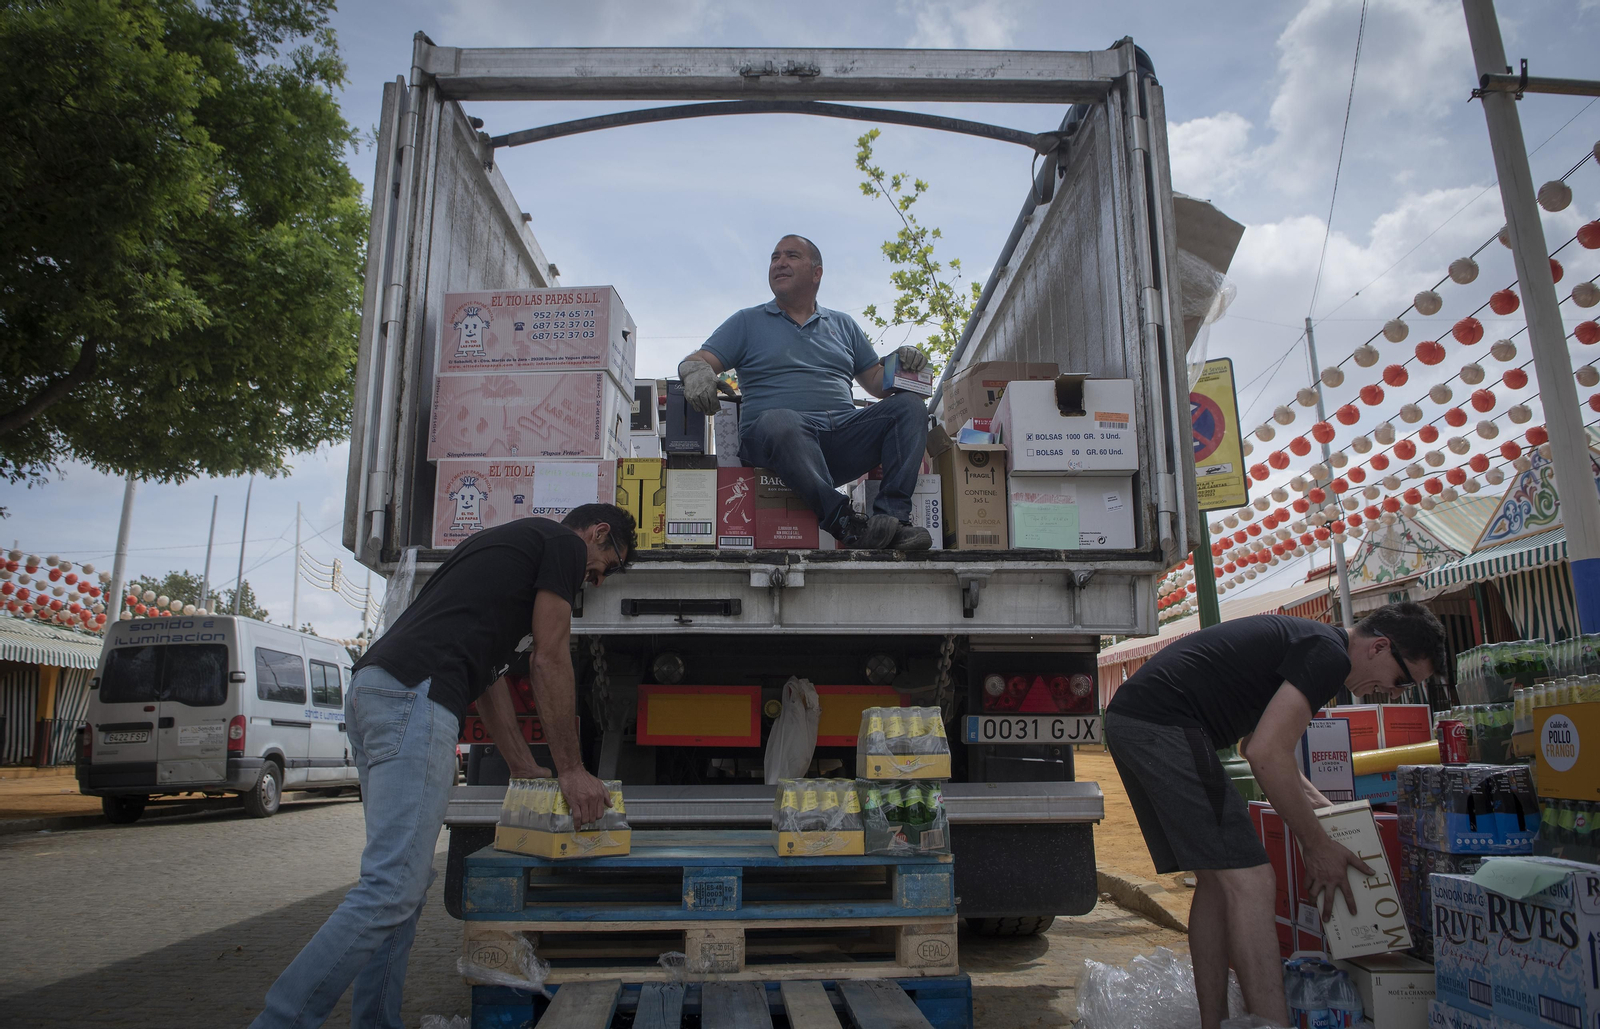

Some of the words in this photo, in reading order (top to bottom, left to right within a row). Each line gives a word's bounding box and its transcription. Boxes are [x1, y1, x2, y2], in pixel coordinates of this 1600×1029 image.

[491, 295, 503, 307] EL
[505, 295, 522, 307] TIO
[524, 294, 542, 306] LAS
[545, 294, 574, 306] PAPAS
[576, 293, 601, 304] S.L.L.
[533, 311, 551, 319] 952
[584, 310, 594, 318] 71
[532, 321, 550, 329] 687
[553, 321, 565, 329] 52
[568, 321, 580, 329] 37
[582, 320, 595, 328] 02
[532, 332, 550, 340] 687
[1035, 433, 1063, 441] BOLSAS
[1105, 432, 1121, 440] Und.
[1108, 448, 1124, 456] Und.
[489, 465, 502, 477] EL
[504, 465, 522, 477] TIO
[524, 465, 535, 477] LA
[760, 475, 785, 488] BAR
[983, 719, 1039, 740] 0031
[1051, 719, 1096, 740] GJX
[109, 733, 128, 742] 6422
[130, 732, 147, 741] FSP
[1548, 730, 1571, 744] POLLO
[1312, 751, 1348, 764] BEEFEATER
[1545, 744, 1576, 758] FRANGO
[1357, 791, 1390, 800] LUMINIO
[1332, 828, 1361, 839] CHANDON
[1434, 886, 1463, 903] LONDON
[1463, 892, 1478, 906] DRY
[1550, 883, 1569, 899] GIN
[1434, 904, 1488, 945] RIVE
[1486, 892, 1579, 949] RIVES
[922, 944, 946, 957] EPAL
[1442, 937, 1489, 966] Original
[1498, 933, 1570, 970] Original
[1443, 978, 1468, 992] NATURAL
[1501, 984, 1538, 1007] NATURAL
[1501, 996, 1539, 1016] INGREDIENTS
